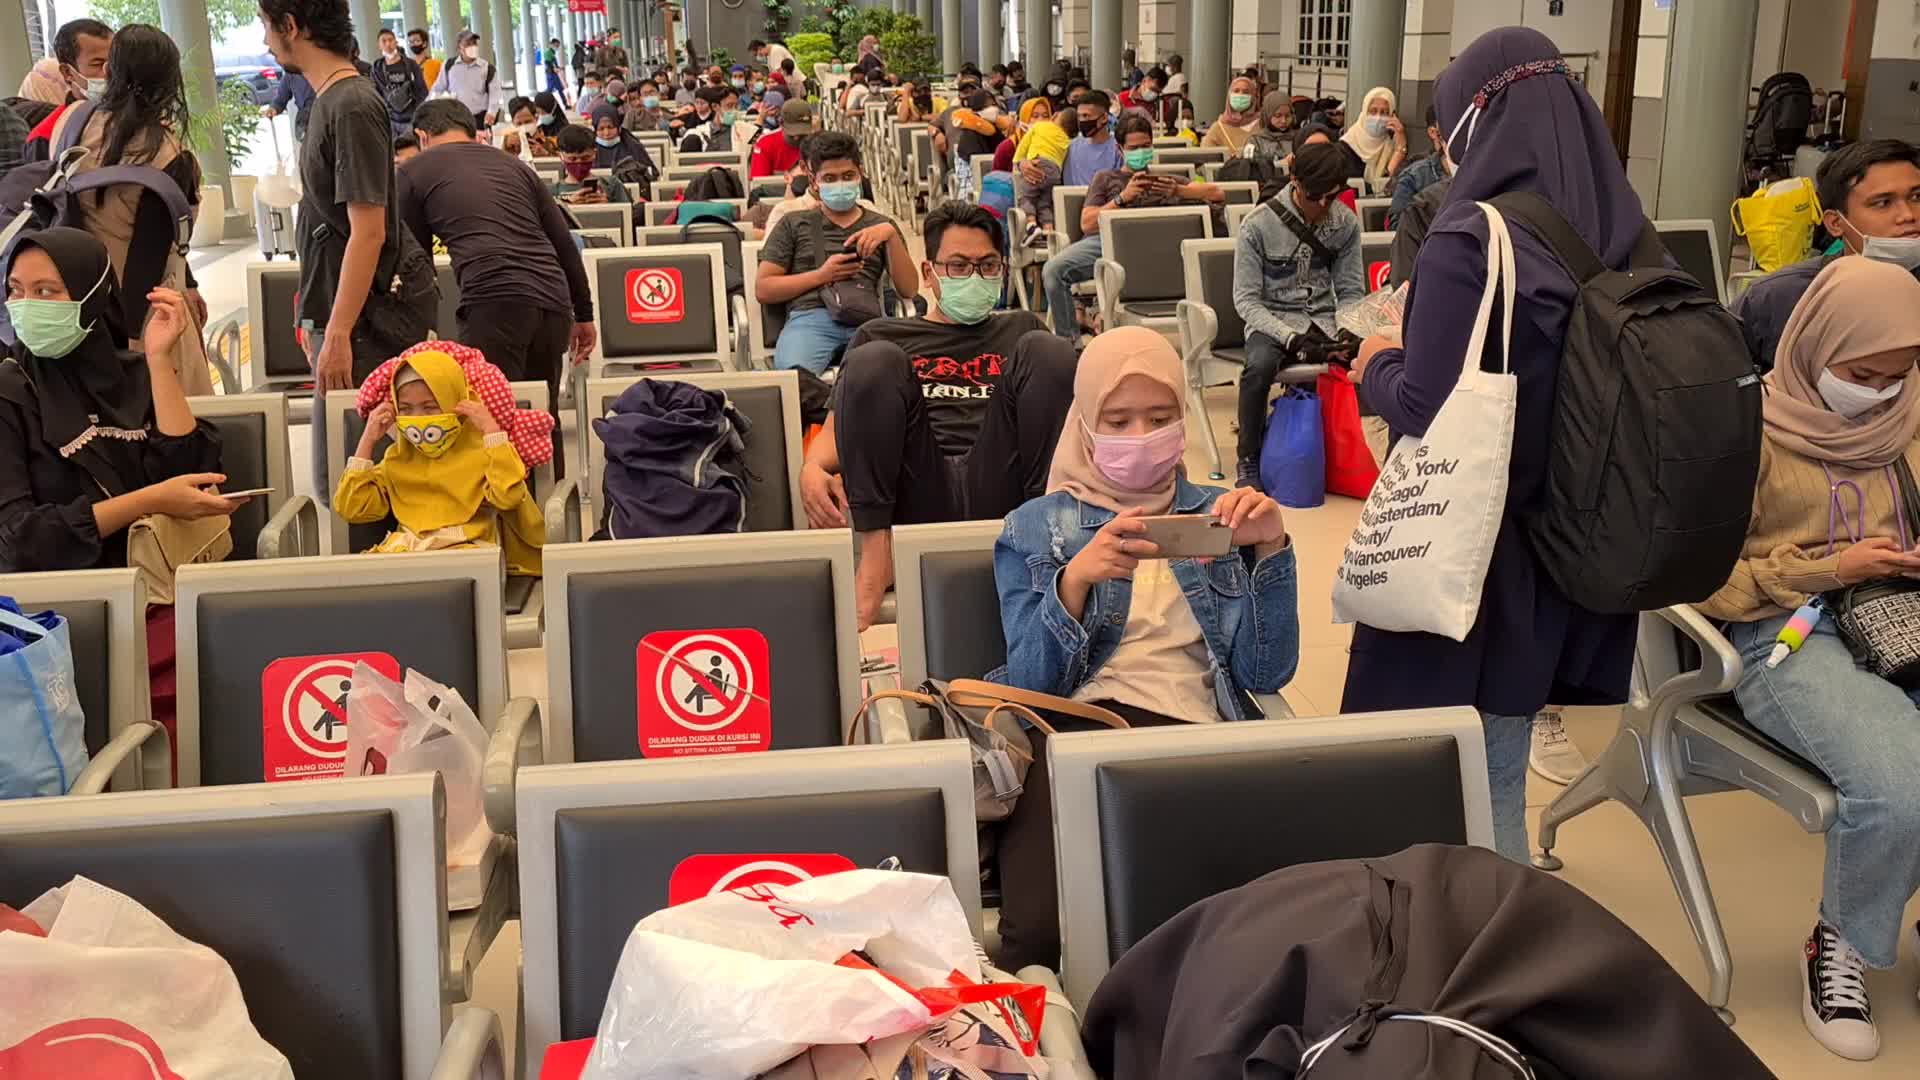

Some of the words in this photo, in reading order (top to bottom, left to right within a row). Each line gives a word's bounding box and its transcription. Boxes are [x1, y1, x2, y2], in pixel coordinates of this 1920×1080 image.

[1416, 459, 1459, 477] York/
[1345, 568, 1388, 590] Angeles
[648, 736, 688, 745] DILARANG
[689, 734, 716, 743] DUDUK
[717, 734, 725, 742] DI
[727, 733, 748, 741] KURSI
[750, 732, 760, 740] INI
[275, 764, 316, 773] DILARANG
